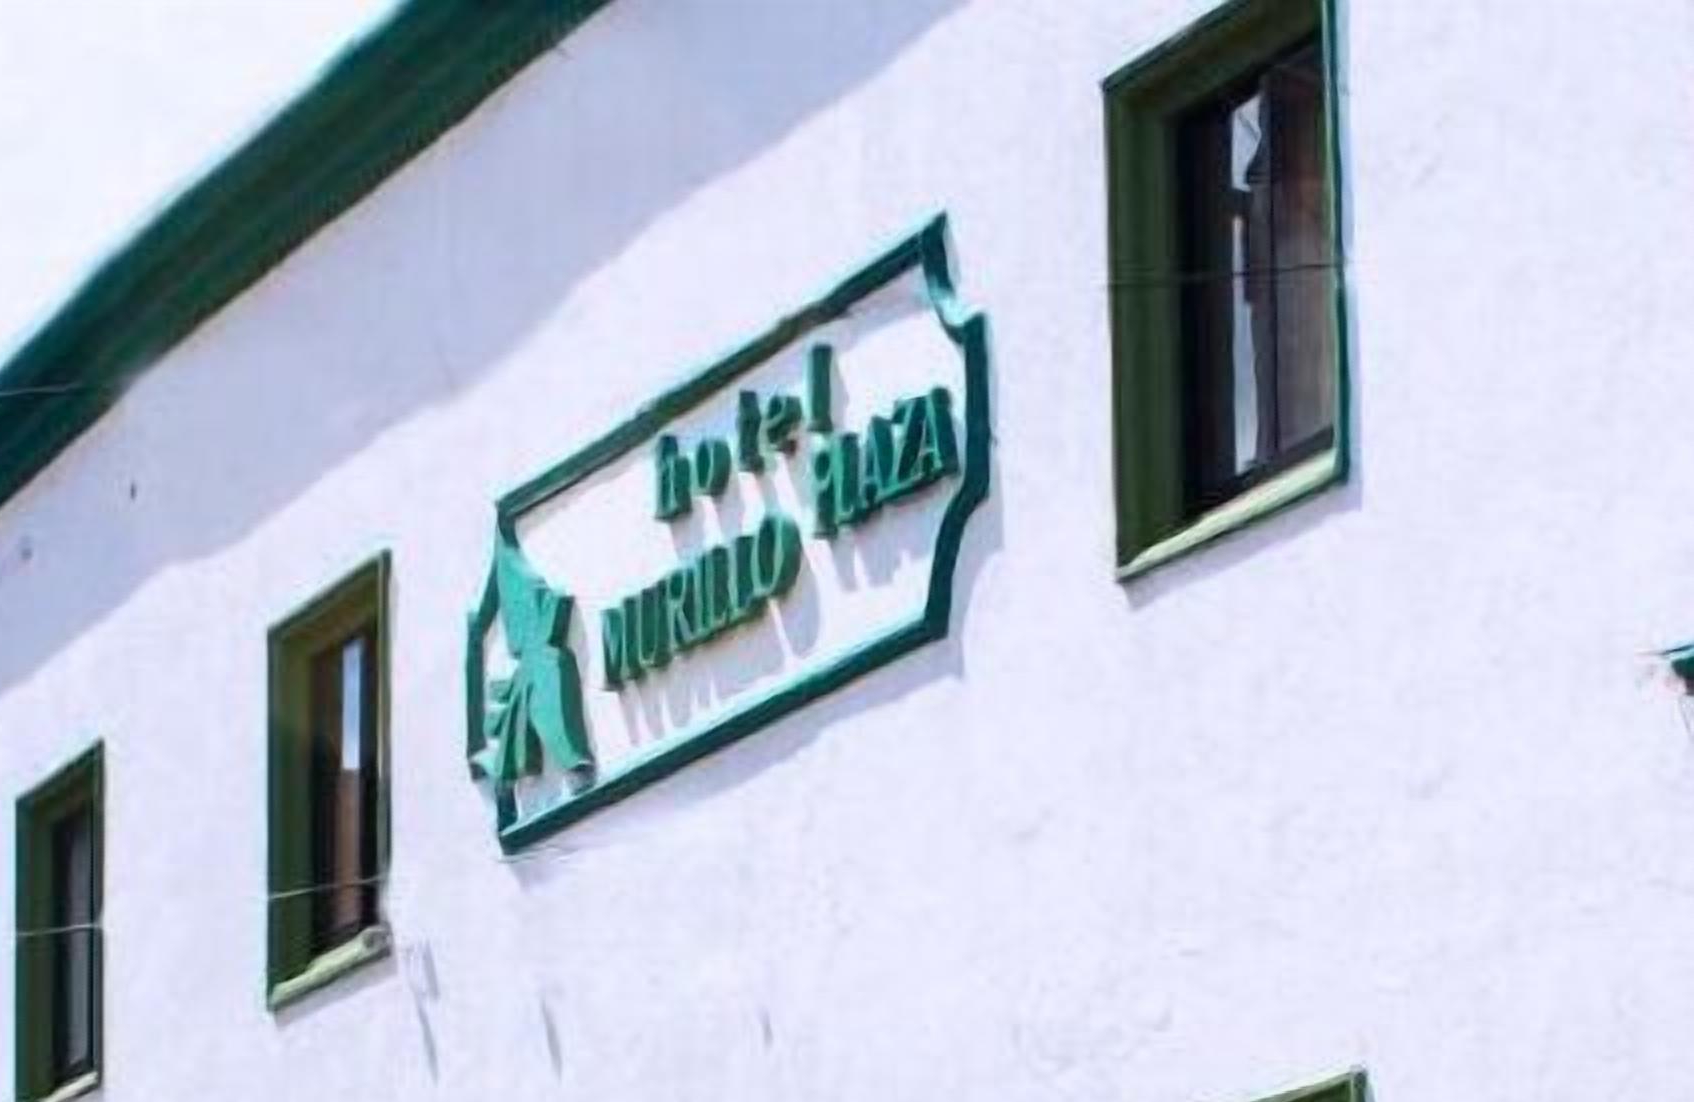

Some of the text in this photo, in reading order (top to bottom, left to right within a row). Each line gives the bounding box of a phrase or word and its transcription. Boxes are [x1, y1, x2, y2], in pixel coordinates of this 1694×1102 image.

[602, 386, 960, 691] MURILLO PLAZA
[654, 344, 834, 521] hotel
